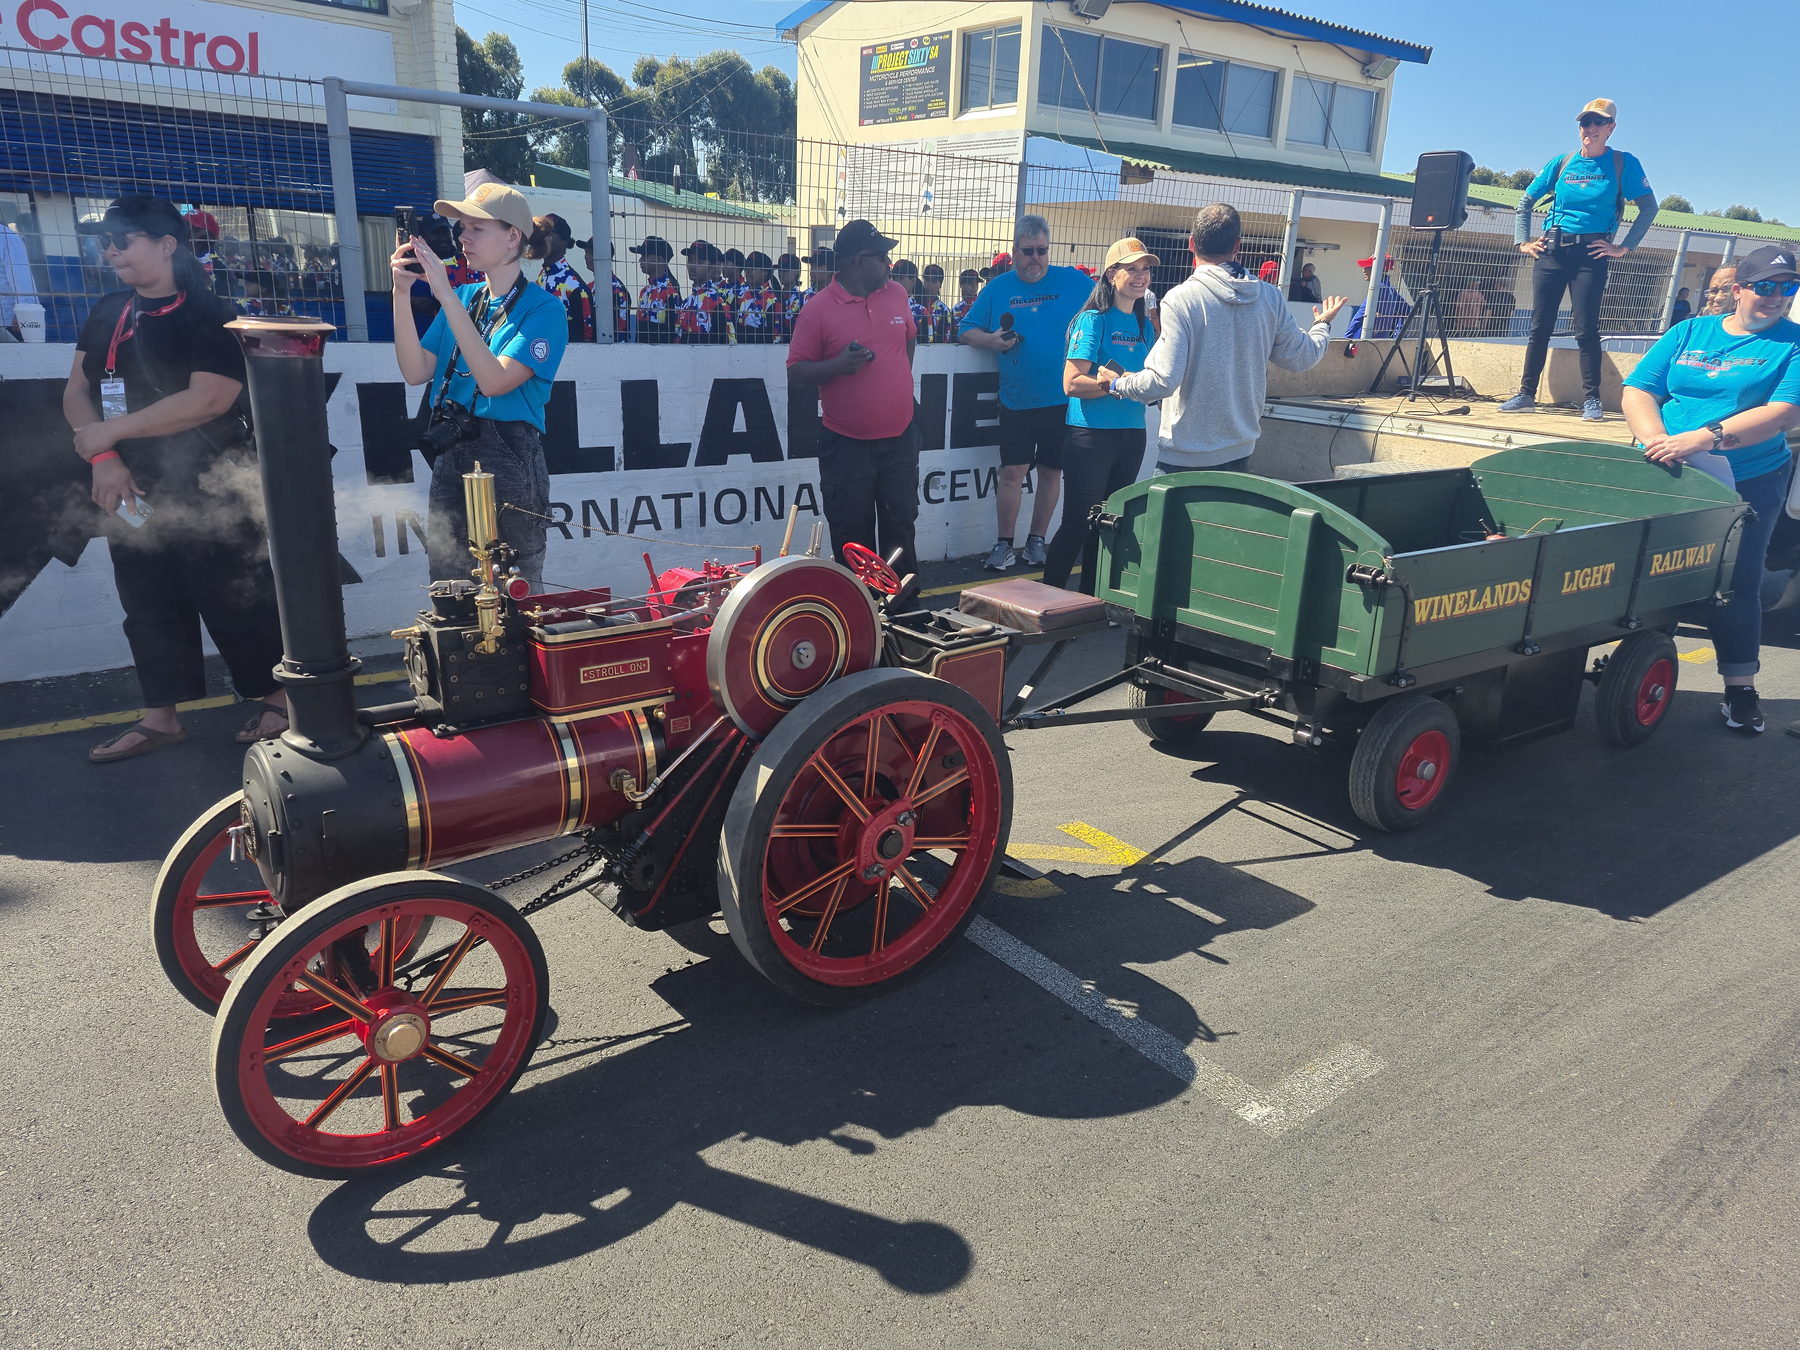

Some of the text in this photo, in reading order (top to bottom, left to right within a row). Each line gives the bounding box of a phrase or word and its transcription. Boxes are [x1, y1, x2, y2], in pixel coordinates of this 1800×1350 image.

[16, 0, 259, 75] Castrol
[899, 66, 936, 78] PERFORMANCE
[1413, 543, 1716, 625] WINELANDS LIGHT RAILWAY
[589, 662, 643, 679] STROLL ON
